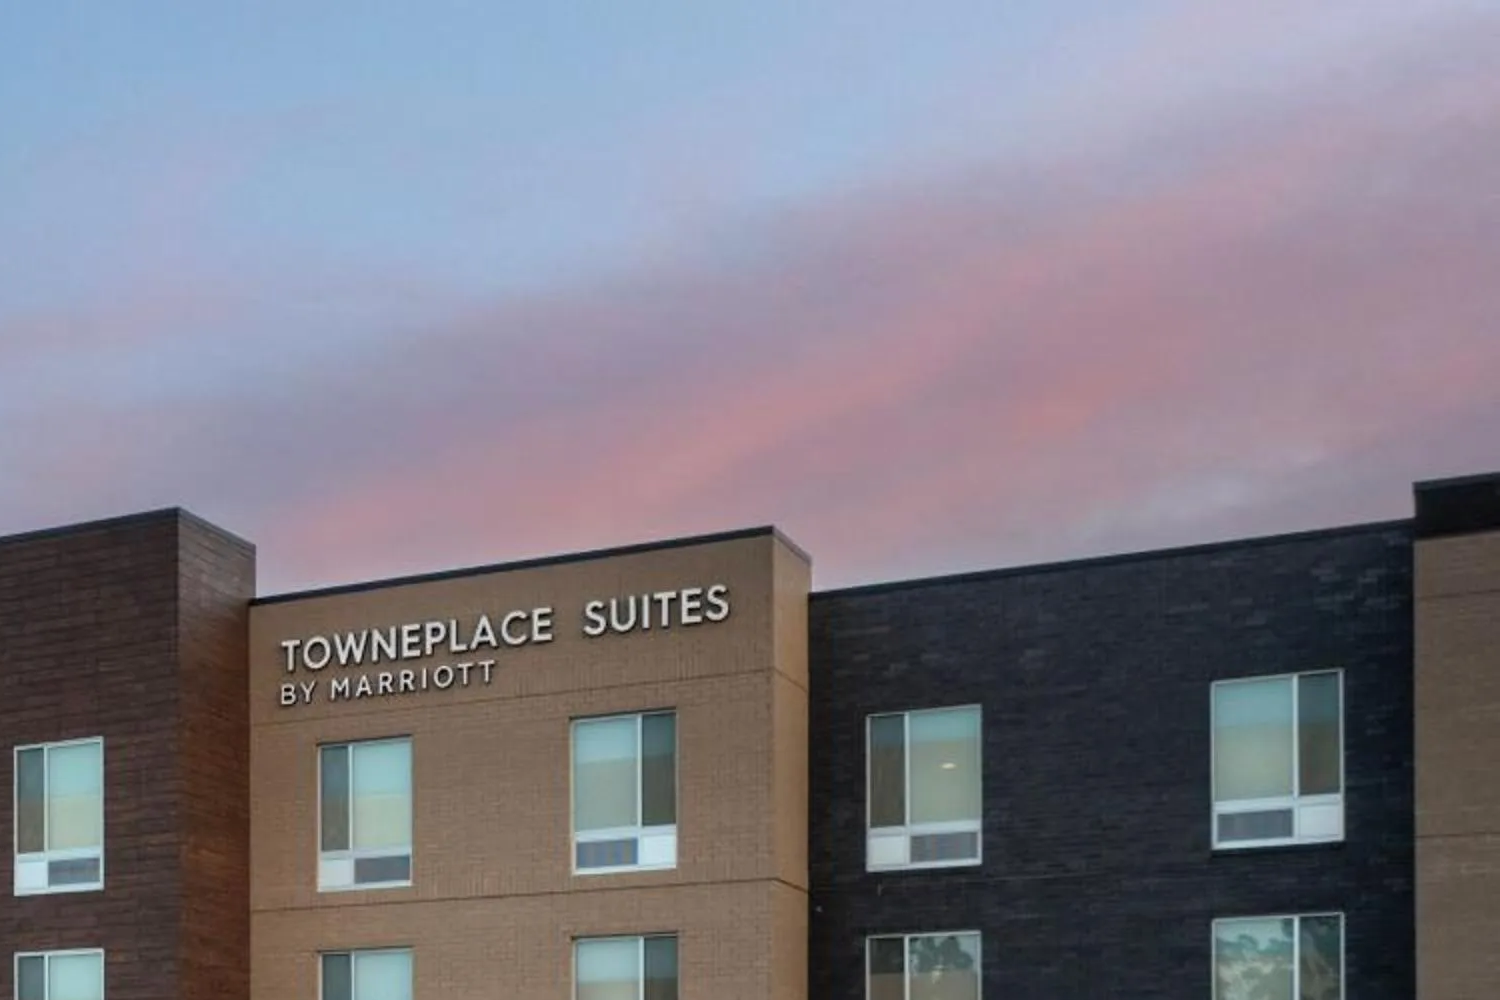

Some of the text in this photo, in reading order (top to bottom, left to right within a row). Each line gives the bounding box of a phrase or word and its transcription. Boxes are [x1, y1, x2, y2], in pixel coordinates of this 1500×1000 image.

[280, 584, 730, 672] TOWNEPLACE SUITES
[280, 660, 497, 706] BY MARRIOTT
